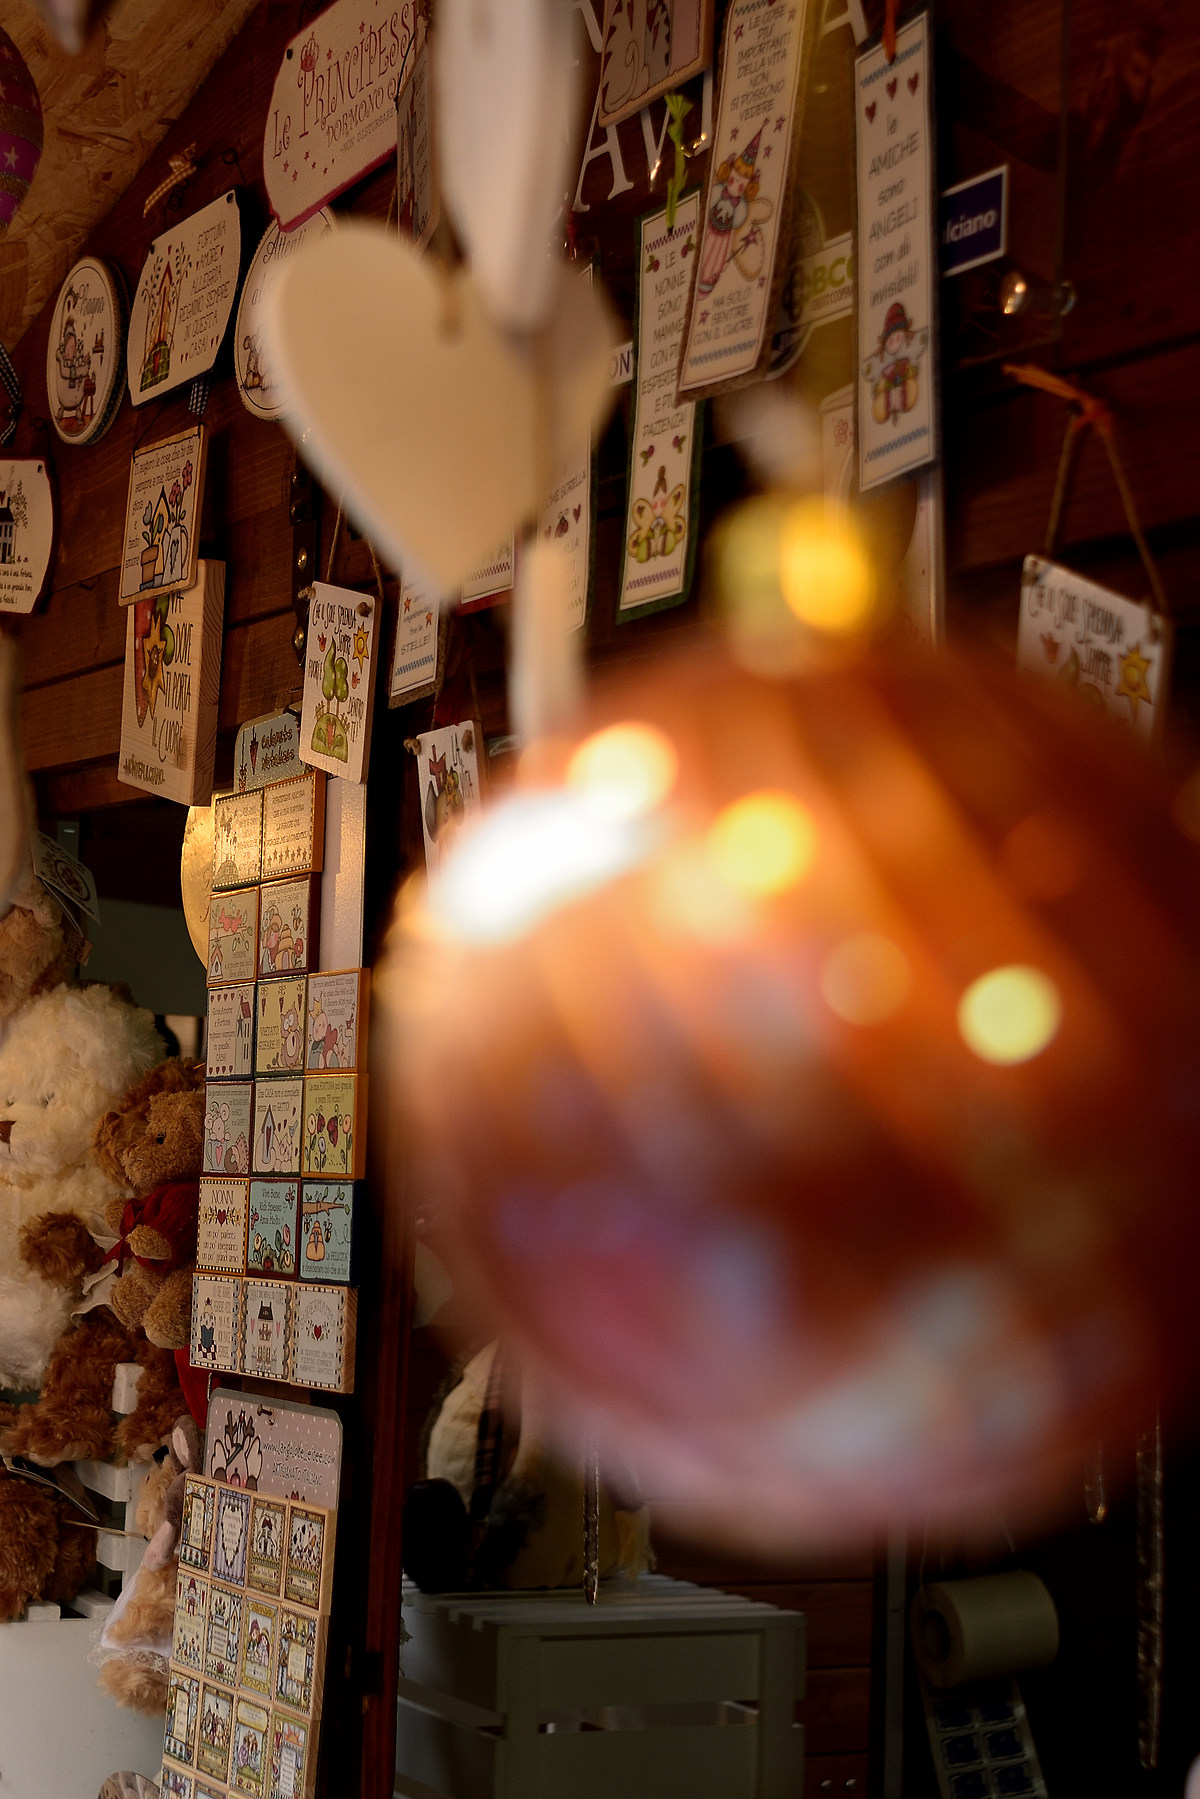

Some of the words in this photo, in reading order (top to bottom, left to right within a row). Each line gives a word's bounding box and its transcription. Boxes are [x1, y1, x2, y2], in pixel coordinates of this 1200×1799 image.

[748, 16, 761, 31] LE
[762, 5, 787, 25] COSE
[737, 31, 791, 66] IMPORTANTI
[737, 58, 766, 80] DELLA
[767, 49, 787, 67] VITA
[740, 79, 785, 106] POSSONO
[748, 71, 770, 90] NON
[326, 86, 384, 148] DORMONO
[739, 98, 775, 123] VEDERE
[868, 131, 920, 180] AMICHE
[877, 178, 906, 207] sono
[868, 196, 919, 244] ANGELI
[942, 206, 999, 246] lciano
[197, 220, 227, 251] FORTUNA
[665, 251, 677, 270] LE
[873, 250, 894, 275] con
[896, 232, 912, 263] ali
[205, 281, 230, 309] SEMPRE
[654, 271, 686, 298] NONNE
[870, 258, 919, 308] invisibili!
[657, 295, 683, 320] SONO
[192, 309, 218, 338] QUESTA
[649, 347, 670, 370] CON
[670, 342, 682, 362] PI
[643, 411, 688, 439] PAZIENZA!
[174, 622, 194, 667] DOVE
[172, 671, 192, 727] PORTA
[158, 717, 184, 763] CUORE
